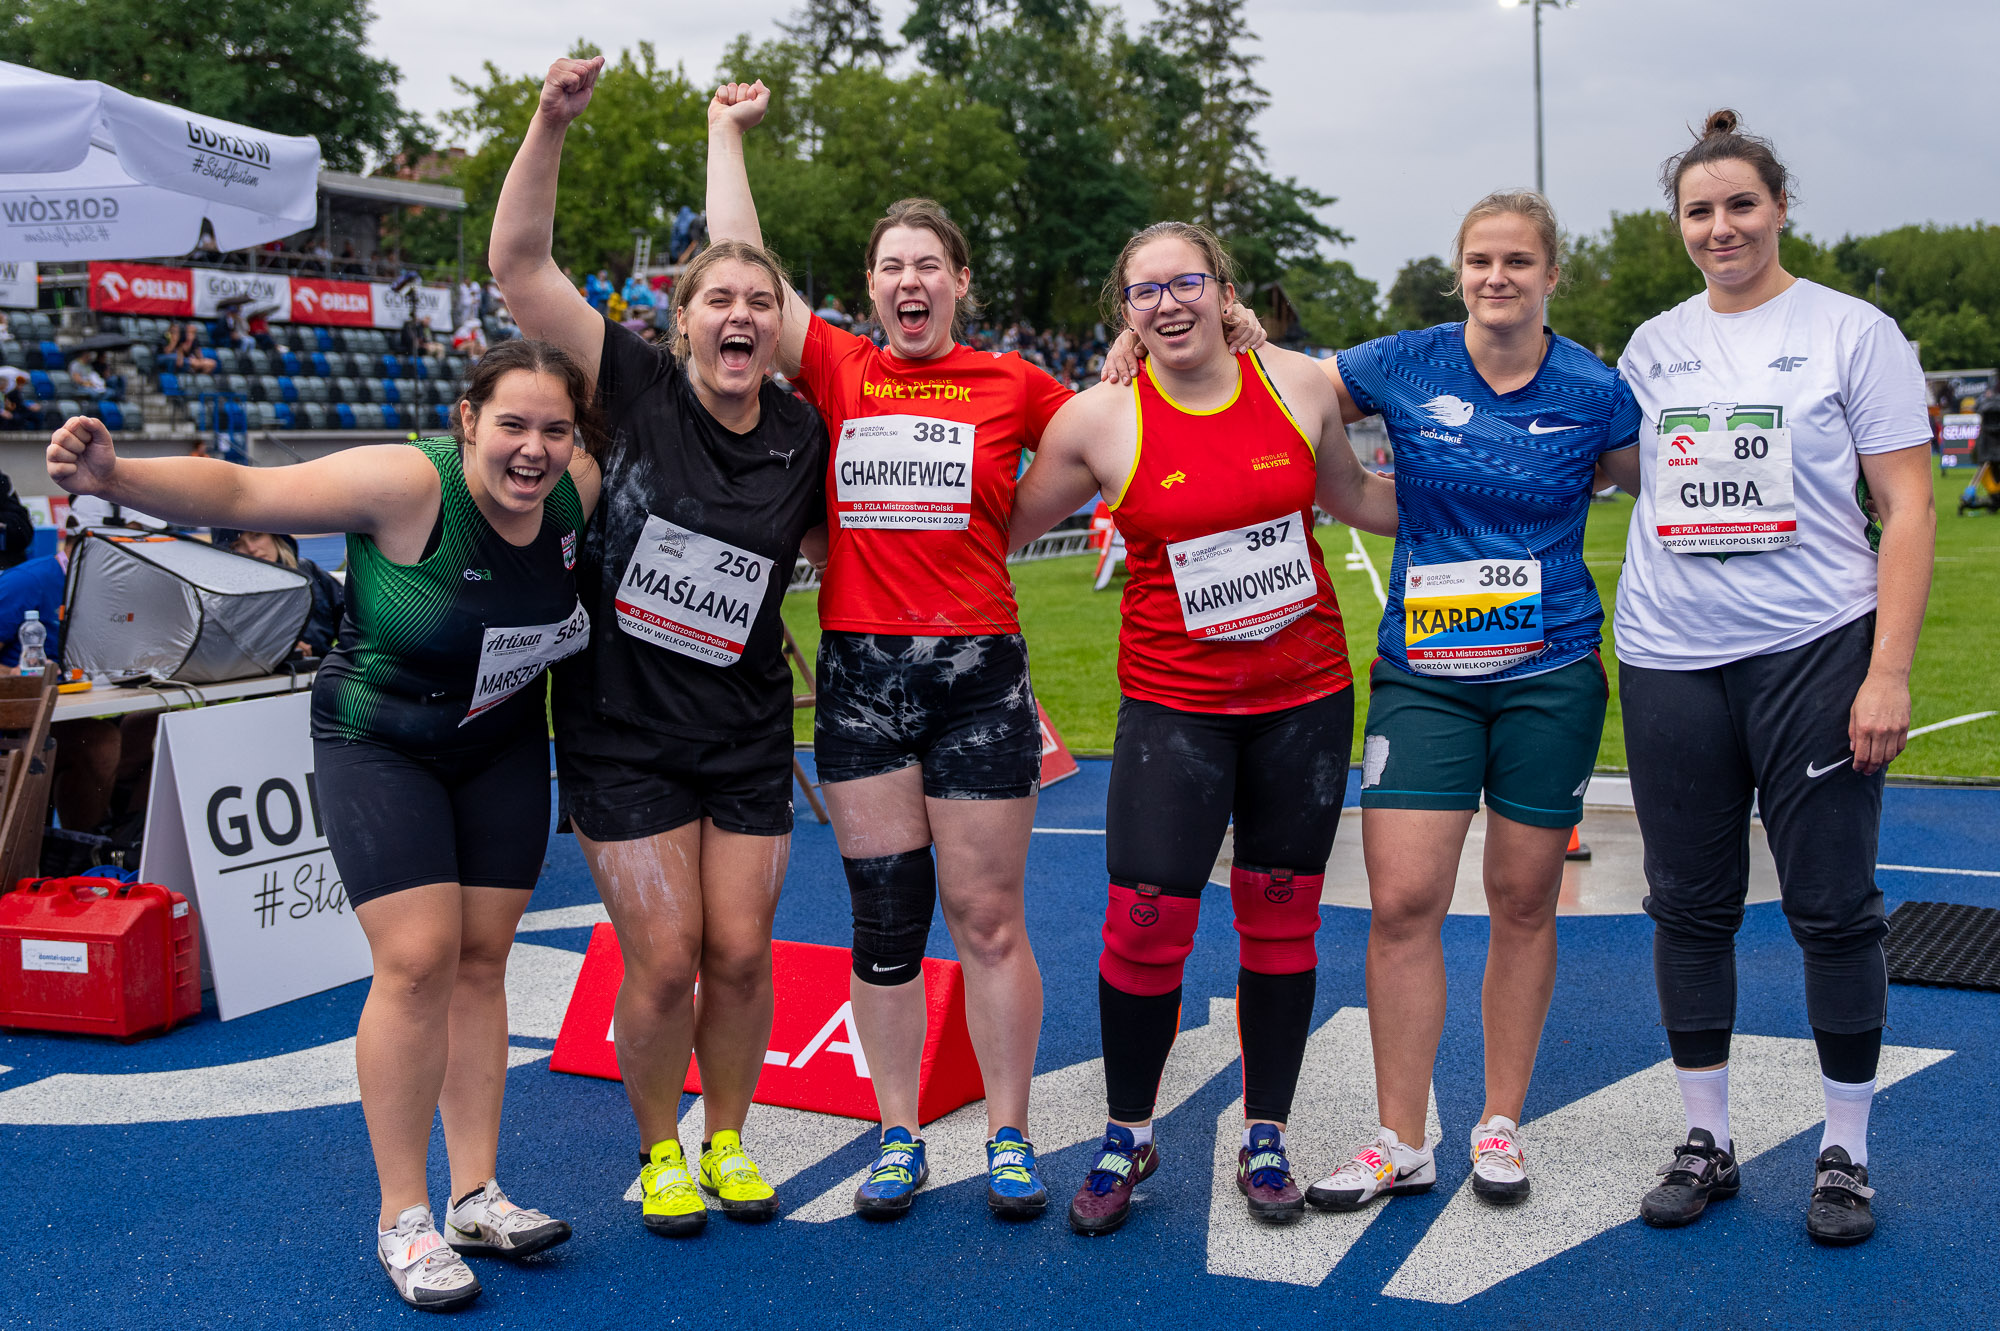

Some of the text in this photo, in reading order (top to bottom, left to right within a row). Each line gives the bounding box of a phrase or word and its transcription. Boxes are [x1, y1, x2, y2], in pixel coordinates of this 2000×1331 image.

[130, 278, 188, 300] ORLEN
[320, 292, 369, 312] ORLEN
[1668, 360, 1701, 373] UMCS
[1767, 356, 1808, 372] 4F
[863, 381, 972, 402] BIAŁYSTOK
[913, 422, 961, 445] 381
[1420, 430, 1463, 444] PODLASKIE
[1734, 436, 1769, 460] 80
[1253, 458, 1291, 471] BIAŁYSTOK
[1668, 457, 1698, 467] ORLEN
[841, 460, 966, 487] CHARKIEWICZ
[1680, 481, 1764, 508] GUBA
[853, 502, 954, 512] 99. PZLA Mistrzostwa Polski
[879, 515, 942, 524] WIELKOPOLSKI
[943, 516, 964, 524] 2023
[1670, 524, 1778, 535] 99. PZLA Mistrzostwa Polski
[1245, 520, 1290, 551] 387
[1699, 537, 1766, 546] WIELKOPOLSKI
[1767, 535, 1790, 543] 2023
[658, 543, 684, 559] Nestlé
[1192, 547, 1233, 563] WIELKOPOLSKI
[714, 551, 761, 582] 250
[1479, 565, 1528, 586] 386
[627, 563, 750, 628] MAŚLANA
[1185, 559, 1310, 614] KARWOWSKA
[629, 607, 728, 648] 99. PZLA Mistrzostwa Polski
[1205, 601, 1304, 635] 99. PZLA Mistrzostwa Polski
[1238, 617, 1294, 639] WIELKOPOLSKI
[1412, 605, 1537, 634] KARDASZ
[486, 611, 584, 652] Artisan 583
[654, 632, 714, 657] WIELKOPOLSKI
[713, 652, 734, 663] 2023
[1423, 646, 1527, 658] 99. PZLA Mistrzostwa Polski
[1415, 662, 1451, 670] GORZÓW
[1453, 658, 1516, 669] WIELKOPOLSKI
[1478, 1137, 1511, 1152] NIKE
[721, 1156, 752, 1176] NIKE
[877, 1152, 913, 1169] NIKE
[992, 1151, 1025, 1169] NIKE
[1249, 1152, 1282, 1172] NIKE
[655, 1168, 688, 1192] NIKE
[1824, 1172, 1863, 1194] NIKE
[406, 1232, 441, 1264] NIKE
